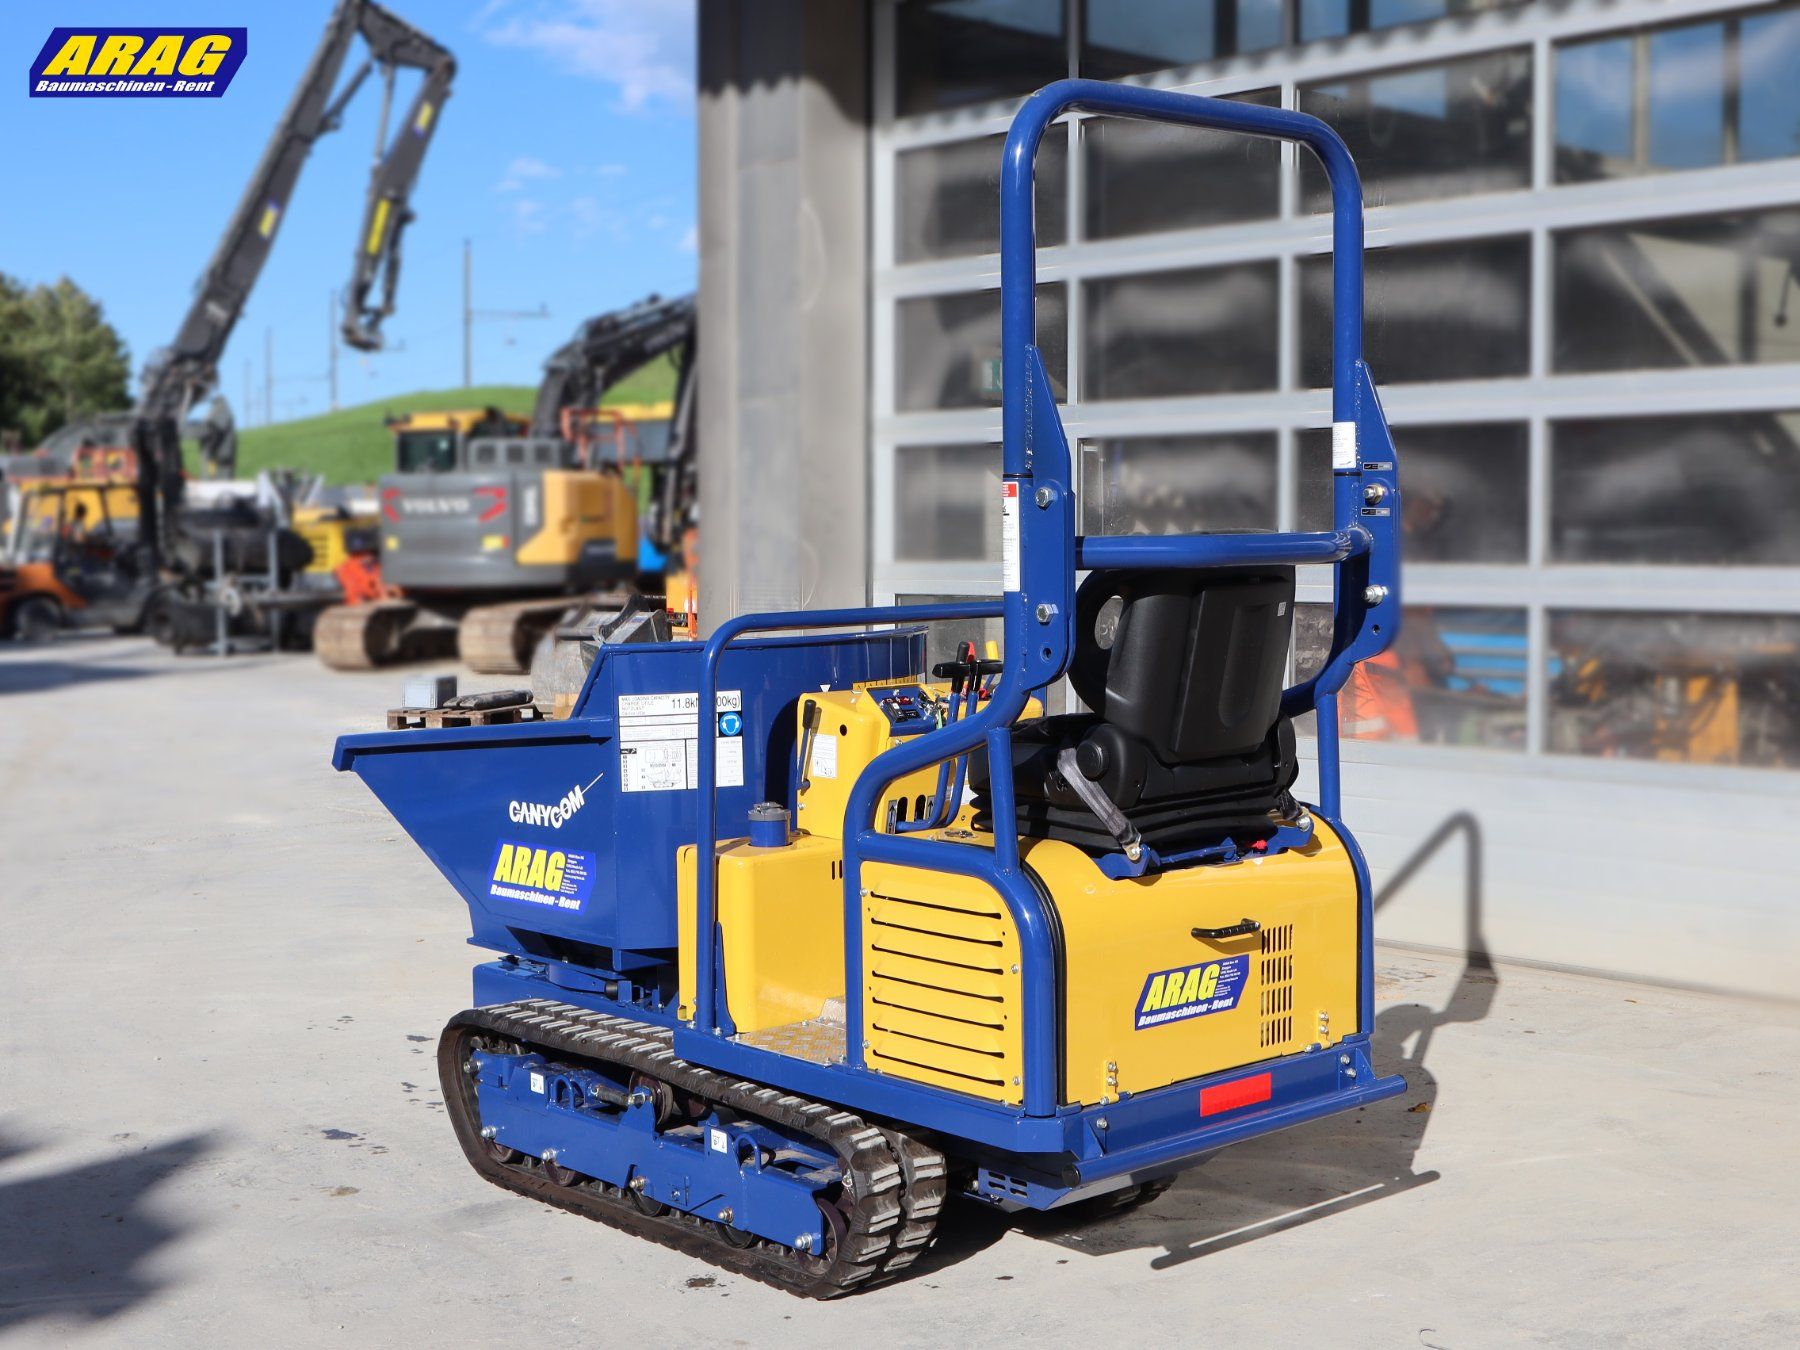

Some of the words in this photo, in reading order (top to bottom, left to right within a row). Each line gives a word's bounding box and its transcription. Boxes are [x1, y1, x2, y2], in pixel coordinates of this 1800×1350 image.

[402, 498, 470, 512] VOLVO
[509, 784, 585, 829] CANYCOM
[493, 843, 566, 892] ARAG
[1142, 963, 1220, 1013] ARAG
